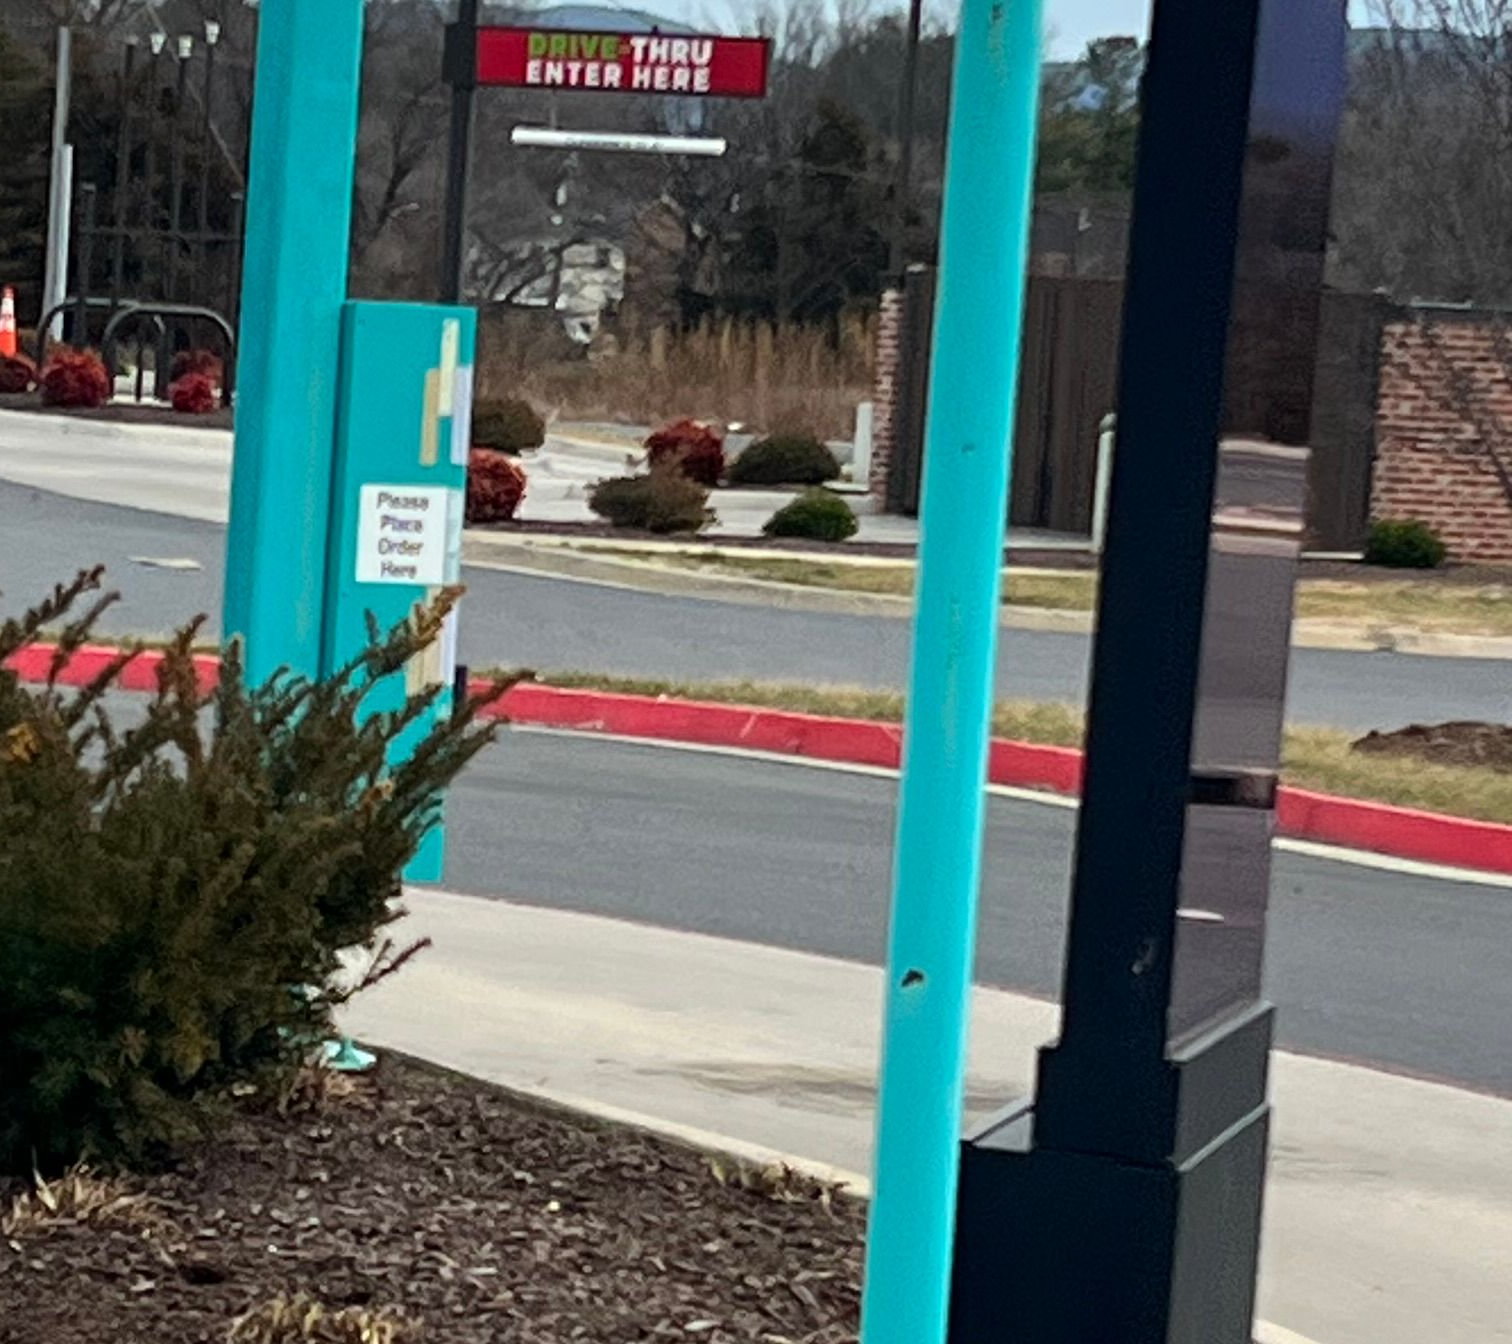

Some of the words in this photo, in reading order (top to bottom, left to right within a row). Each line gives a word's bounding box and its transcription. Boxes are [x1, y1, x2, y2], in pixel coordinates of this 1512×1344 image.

[526, 59, 623, 88] ENTER
[632, 66, 711, 93] HERE
[376, 492, 430, 511] Please
[378, 537, 425, 556] Order
[380, 560, 418, 579] Here
